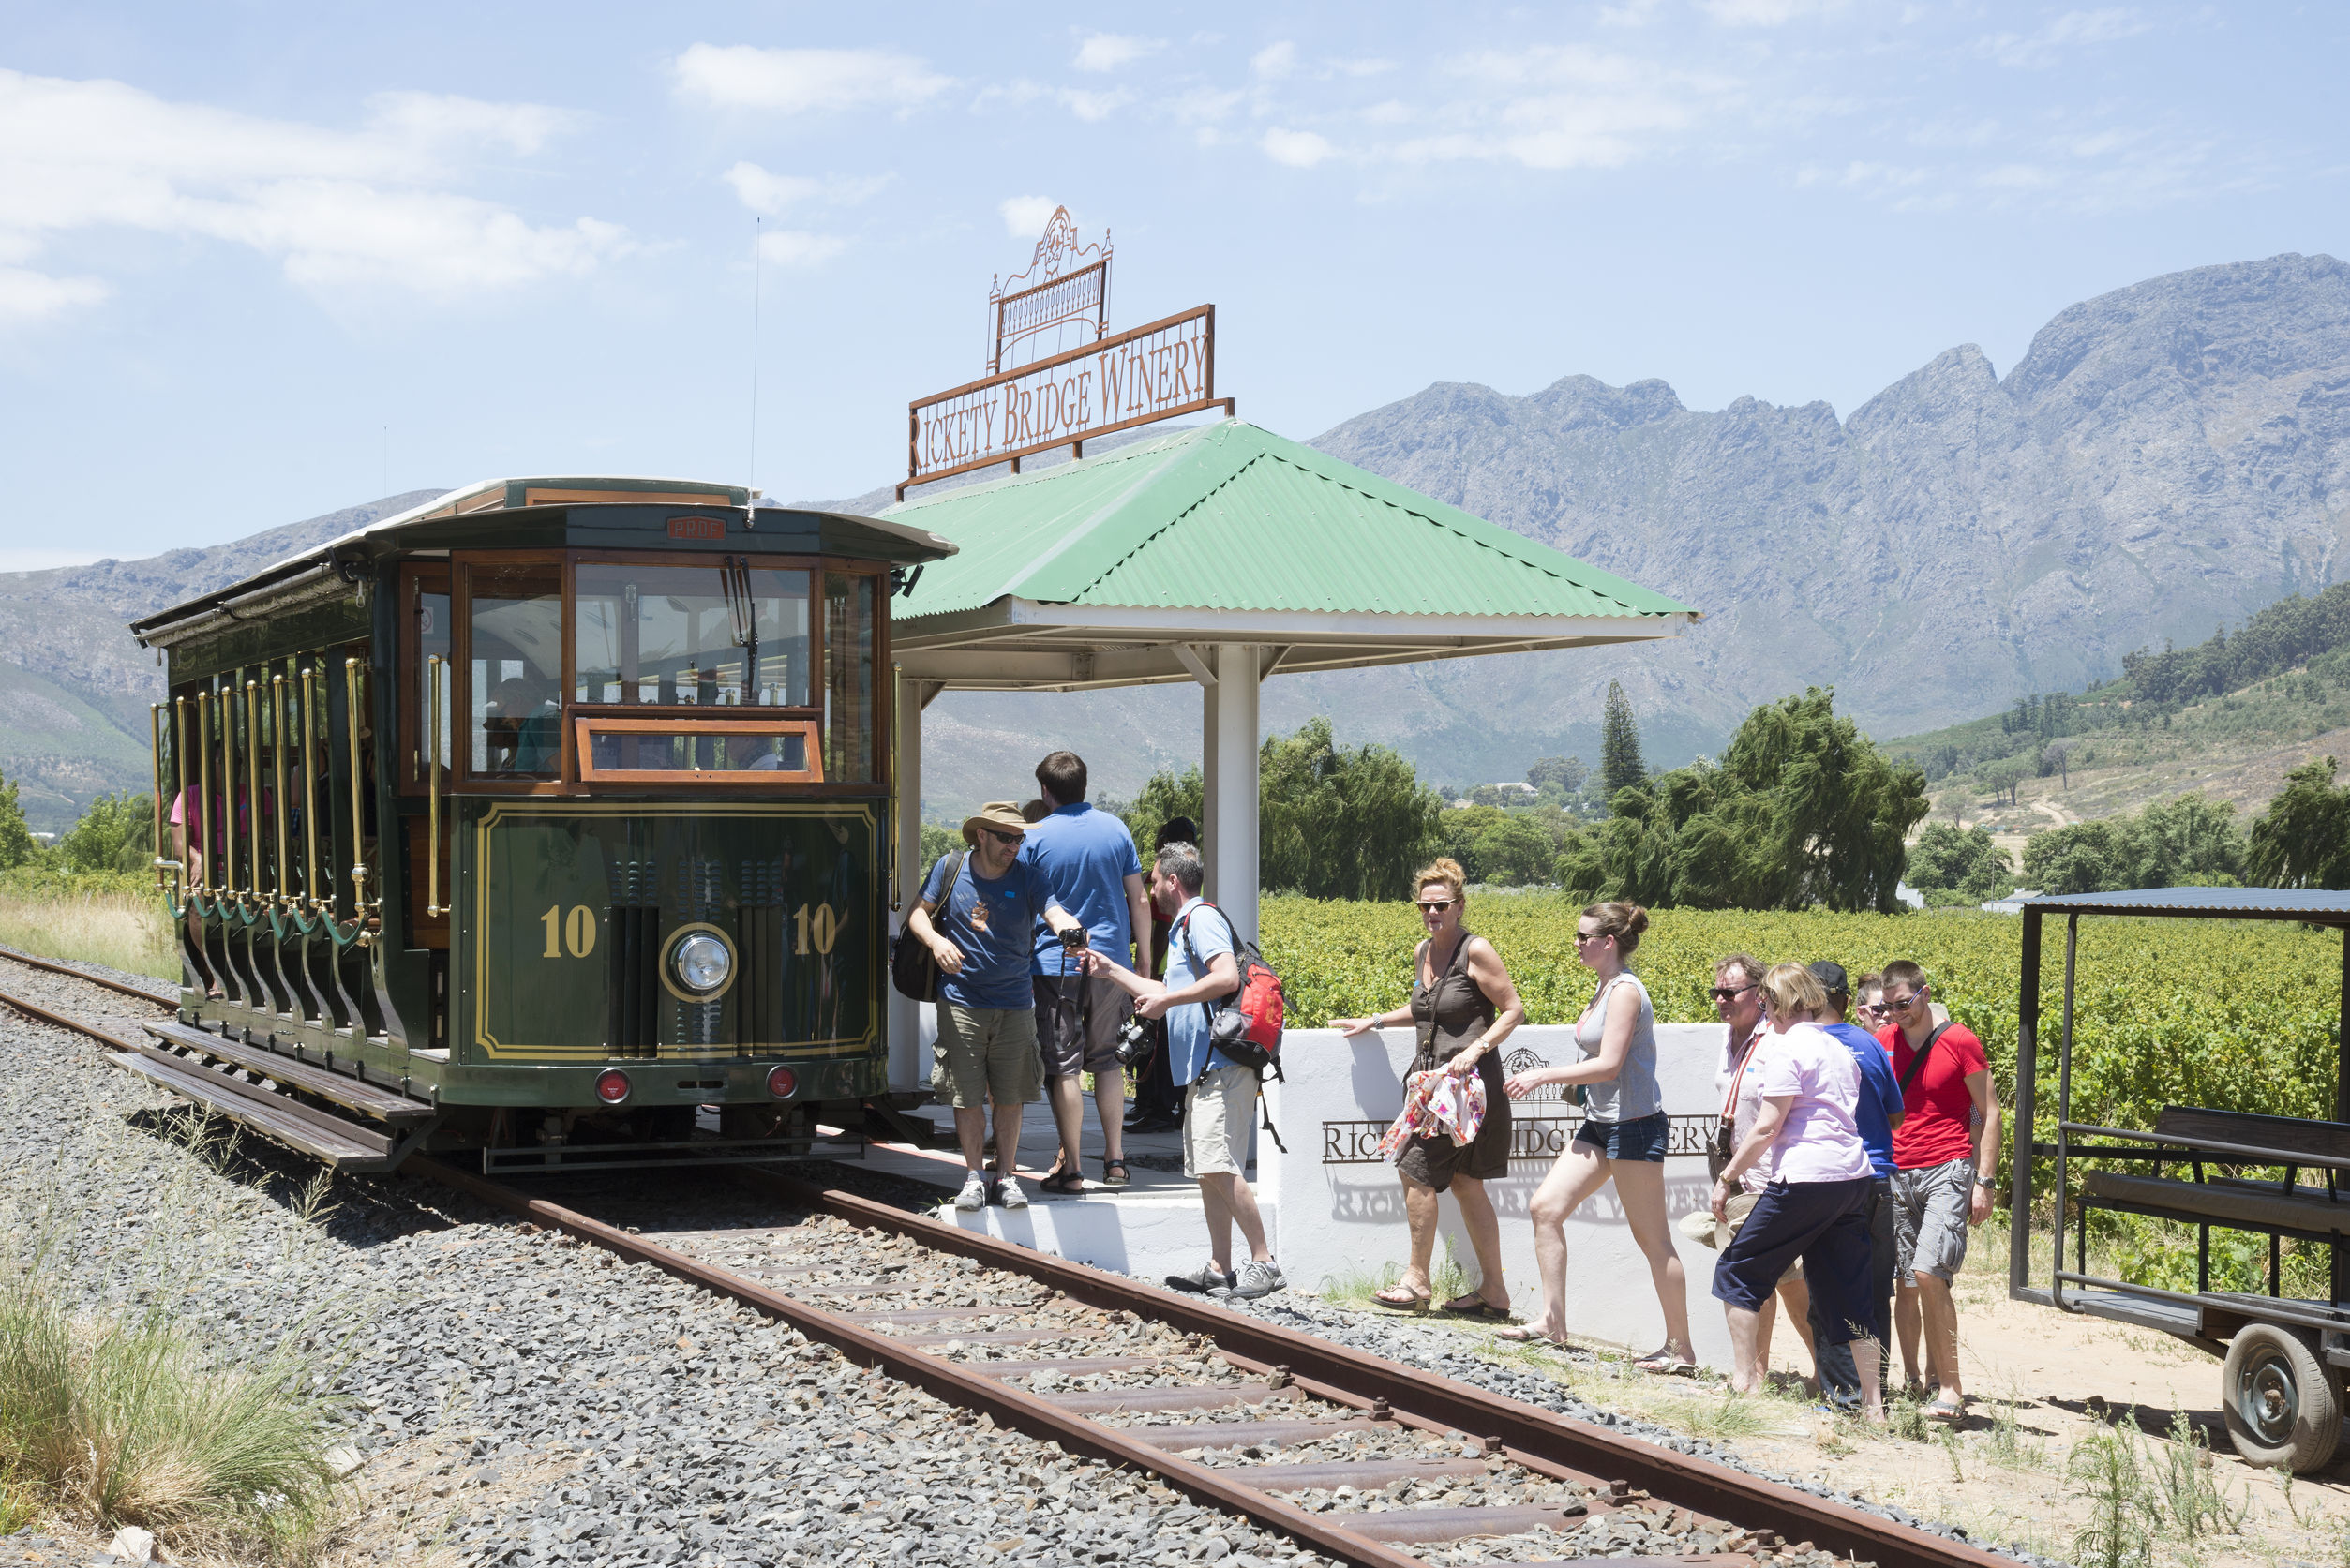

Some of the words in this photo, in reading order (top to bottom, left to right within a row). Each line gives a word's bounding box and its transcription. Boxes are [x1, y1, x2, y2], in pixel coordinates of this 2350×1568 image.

[908, 400, 998, 472] RICKETY
[1002, 371, 1092, 446] BRIDGE
[1098, 333, 1209, 421] WINERY
[540, 904, 597, 959] 10
[792, 903, 836, 955] 10
